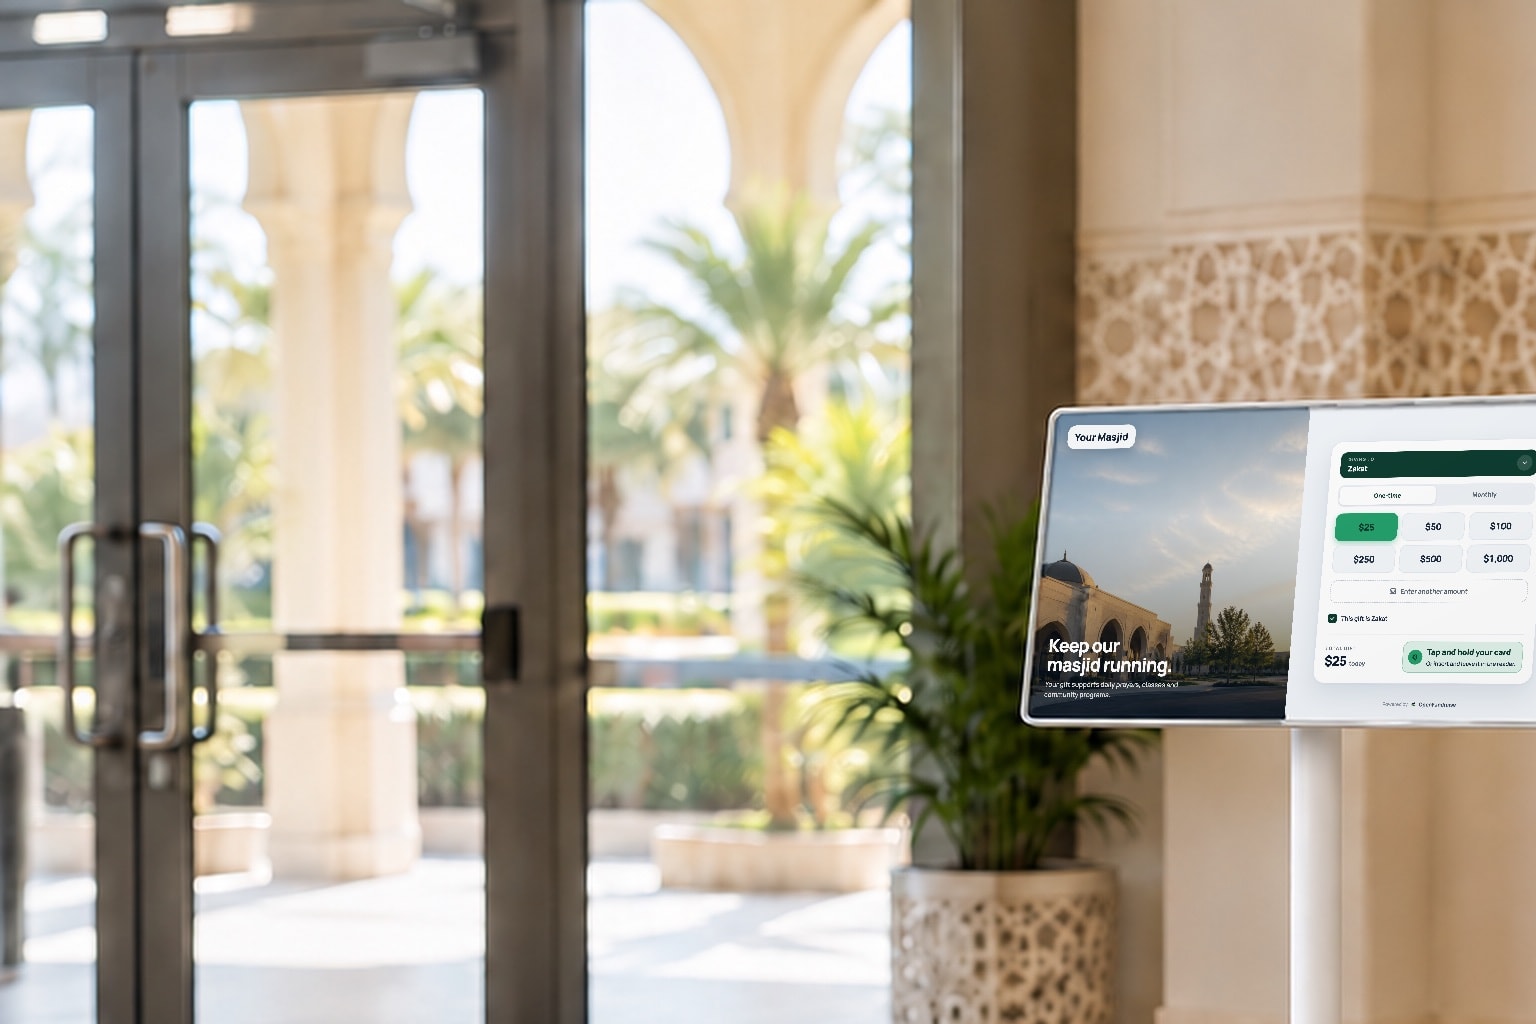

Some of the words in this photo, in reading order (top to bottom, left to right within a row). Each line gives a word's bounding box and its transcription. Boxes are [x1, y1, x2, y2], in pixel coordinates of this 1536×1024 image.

[1074, 433, 1097, 442] Your
[1097, 432, 1129, 444] Masjid
[1358, 523, 1375, 533] $25
[1425, 522, 1442, 532] $50
[1489, 521, 1512, 531] $100
[1353, 554, 1375, 565] $250
[1419, 554, 1442, 564] $500
[1483, 554, 1514, 564] $1,000
[1048, 638, 1090, 658] Keep
[1091, 641, 1121, 653] our
[1426, 648, 1441, 657] Tap
[1441, 648, 1457, 656] and
[1457, 648, 1475, 656] hold
[1493, 648, 1512, 656] card
[1324, 654, 1347, 668] $25
[1047, 657, 1100, 677] masjid
[1103, 657, 1172, 677] running.
